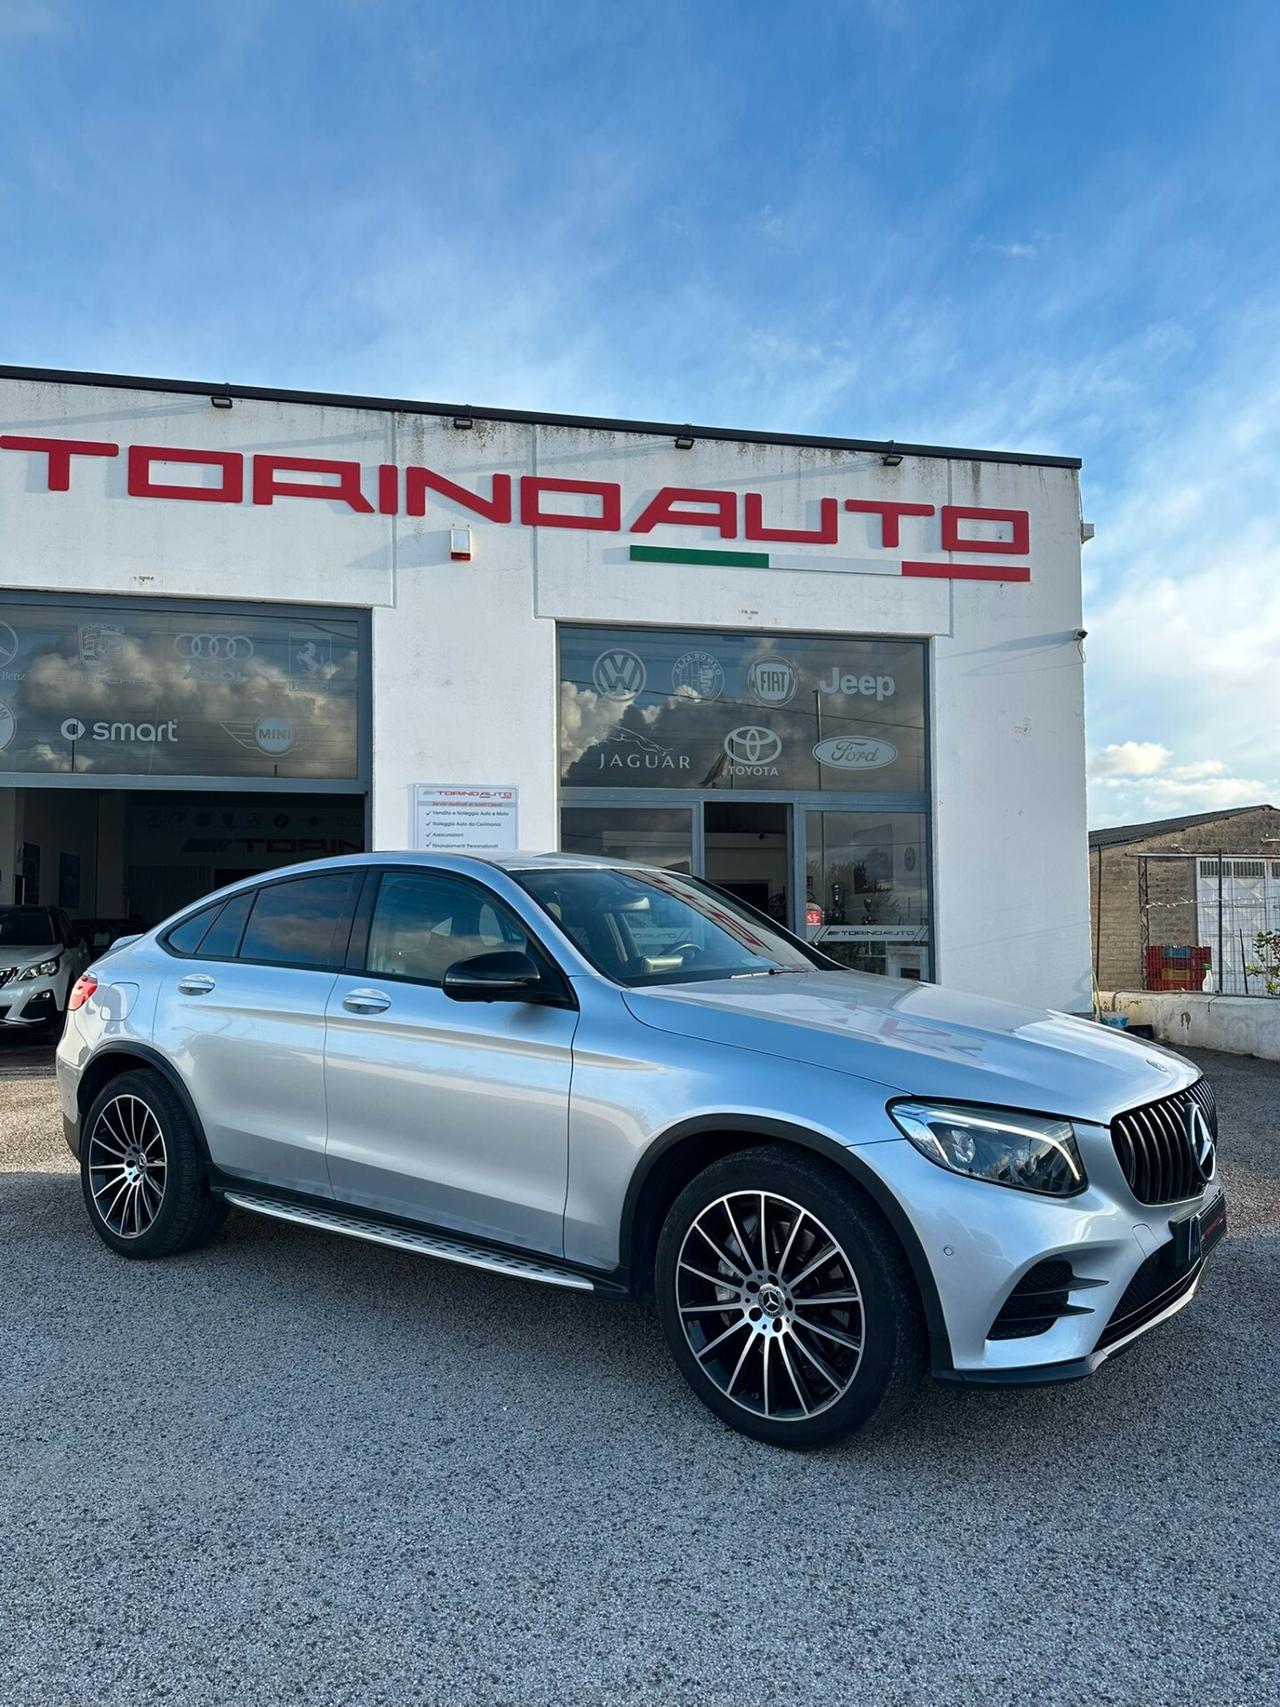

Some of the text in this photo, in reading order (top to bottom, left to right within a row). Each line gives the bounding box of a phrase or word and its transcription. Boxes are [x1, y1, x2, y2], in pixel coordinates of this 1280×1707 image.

[760, 671, 788, 693] FIAT
[819, 666, 896, 701] Jeep
[92, 719, 178, 743] smart
[258, 727, 292, 741] MINI
[599, 751, 691, 771] JAGUAR
[830, 739, 880, 765] Ford
[727, 765, 779, 777] TOYOTA
